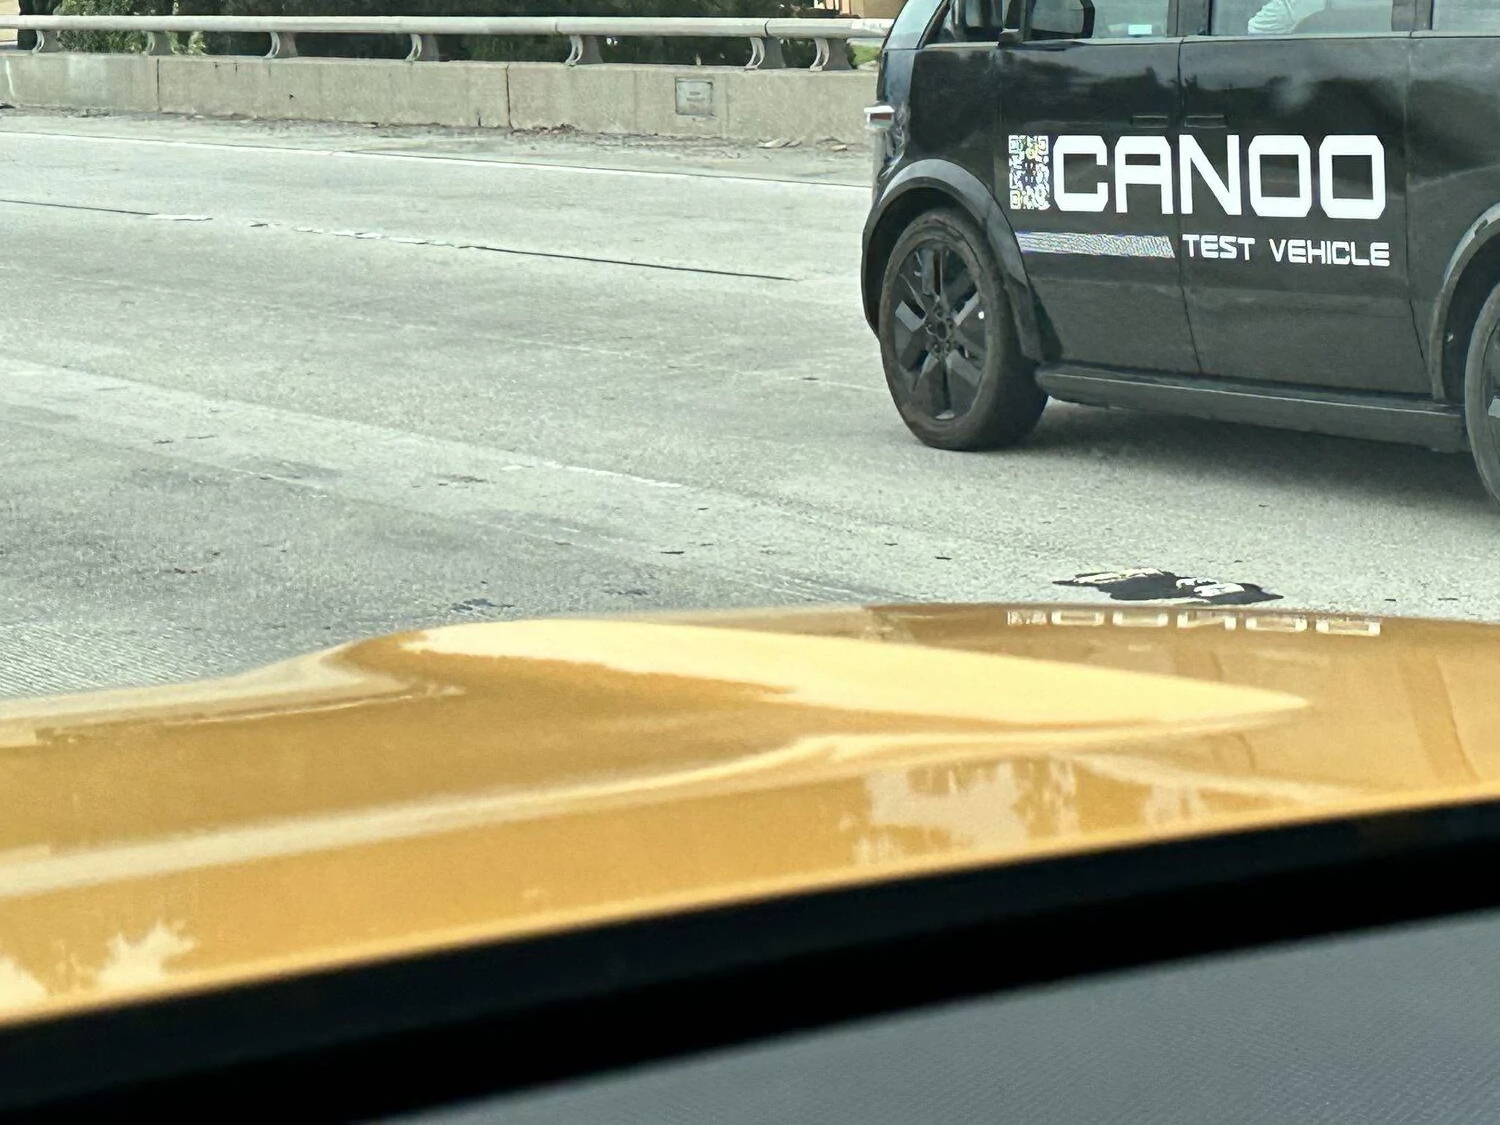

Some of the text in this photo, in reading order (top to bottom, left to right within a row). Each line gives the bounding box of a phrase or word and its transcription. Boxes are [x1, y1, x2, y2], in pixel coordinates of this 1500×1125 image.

[1053, 134, 1386, 220] CANOO
[1181, 233, 1391, 267] TEST VEHICLE
